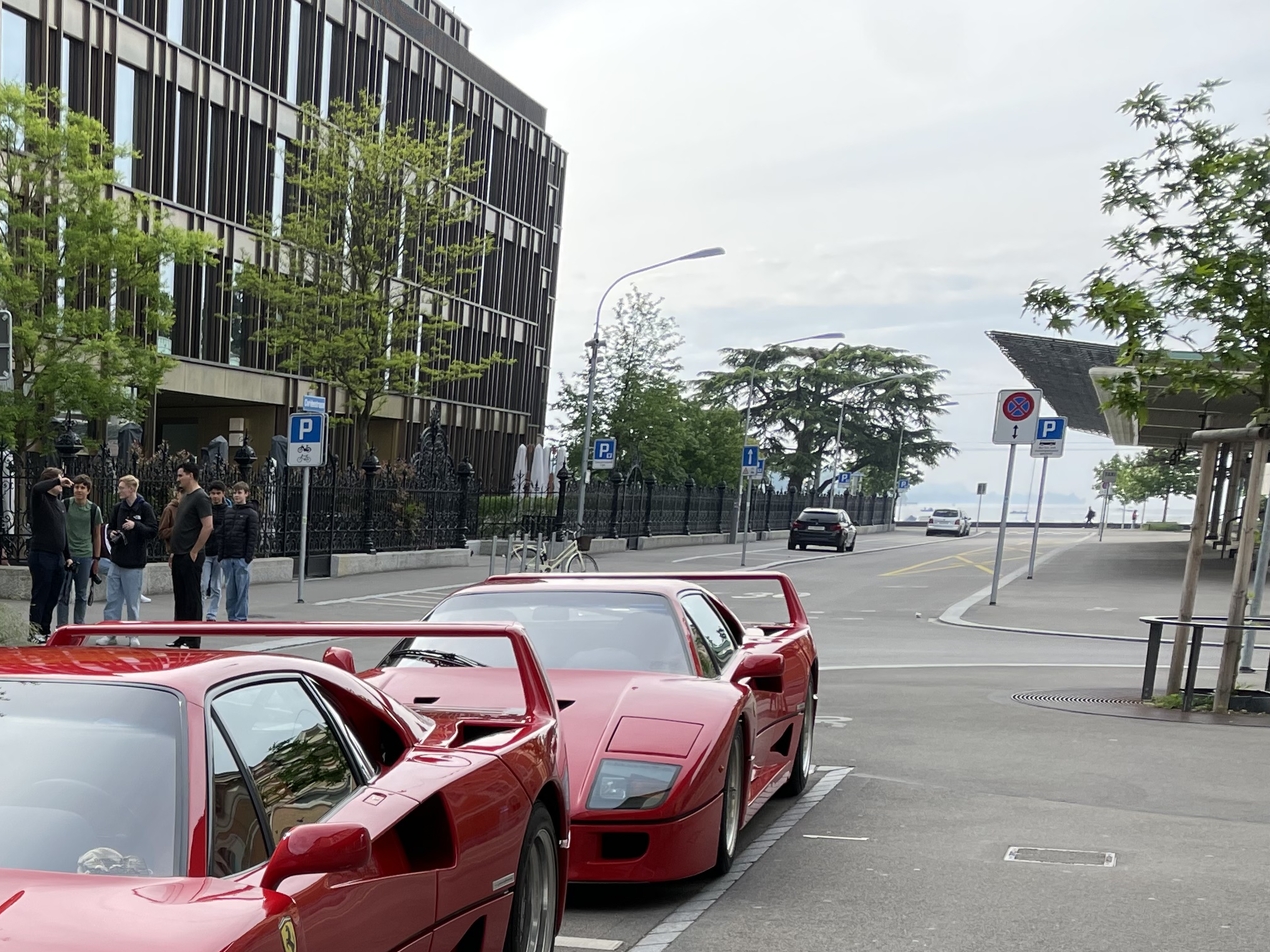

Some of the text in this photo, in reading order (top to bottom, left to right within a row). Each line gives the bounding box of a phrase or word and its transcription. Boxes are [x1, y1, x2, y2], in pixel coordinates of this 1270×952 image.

[299, 418, 313, 440] P
[1042, 420, 1056, 438] P
[598, 443, 610, 458] P
[841, 473, 848, 483] P
